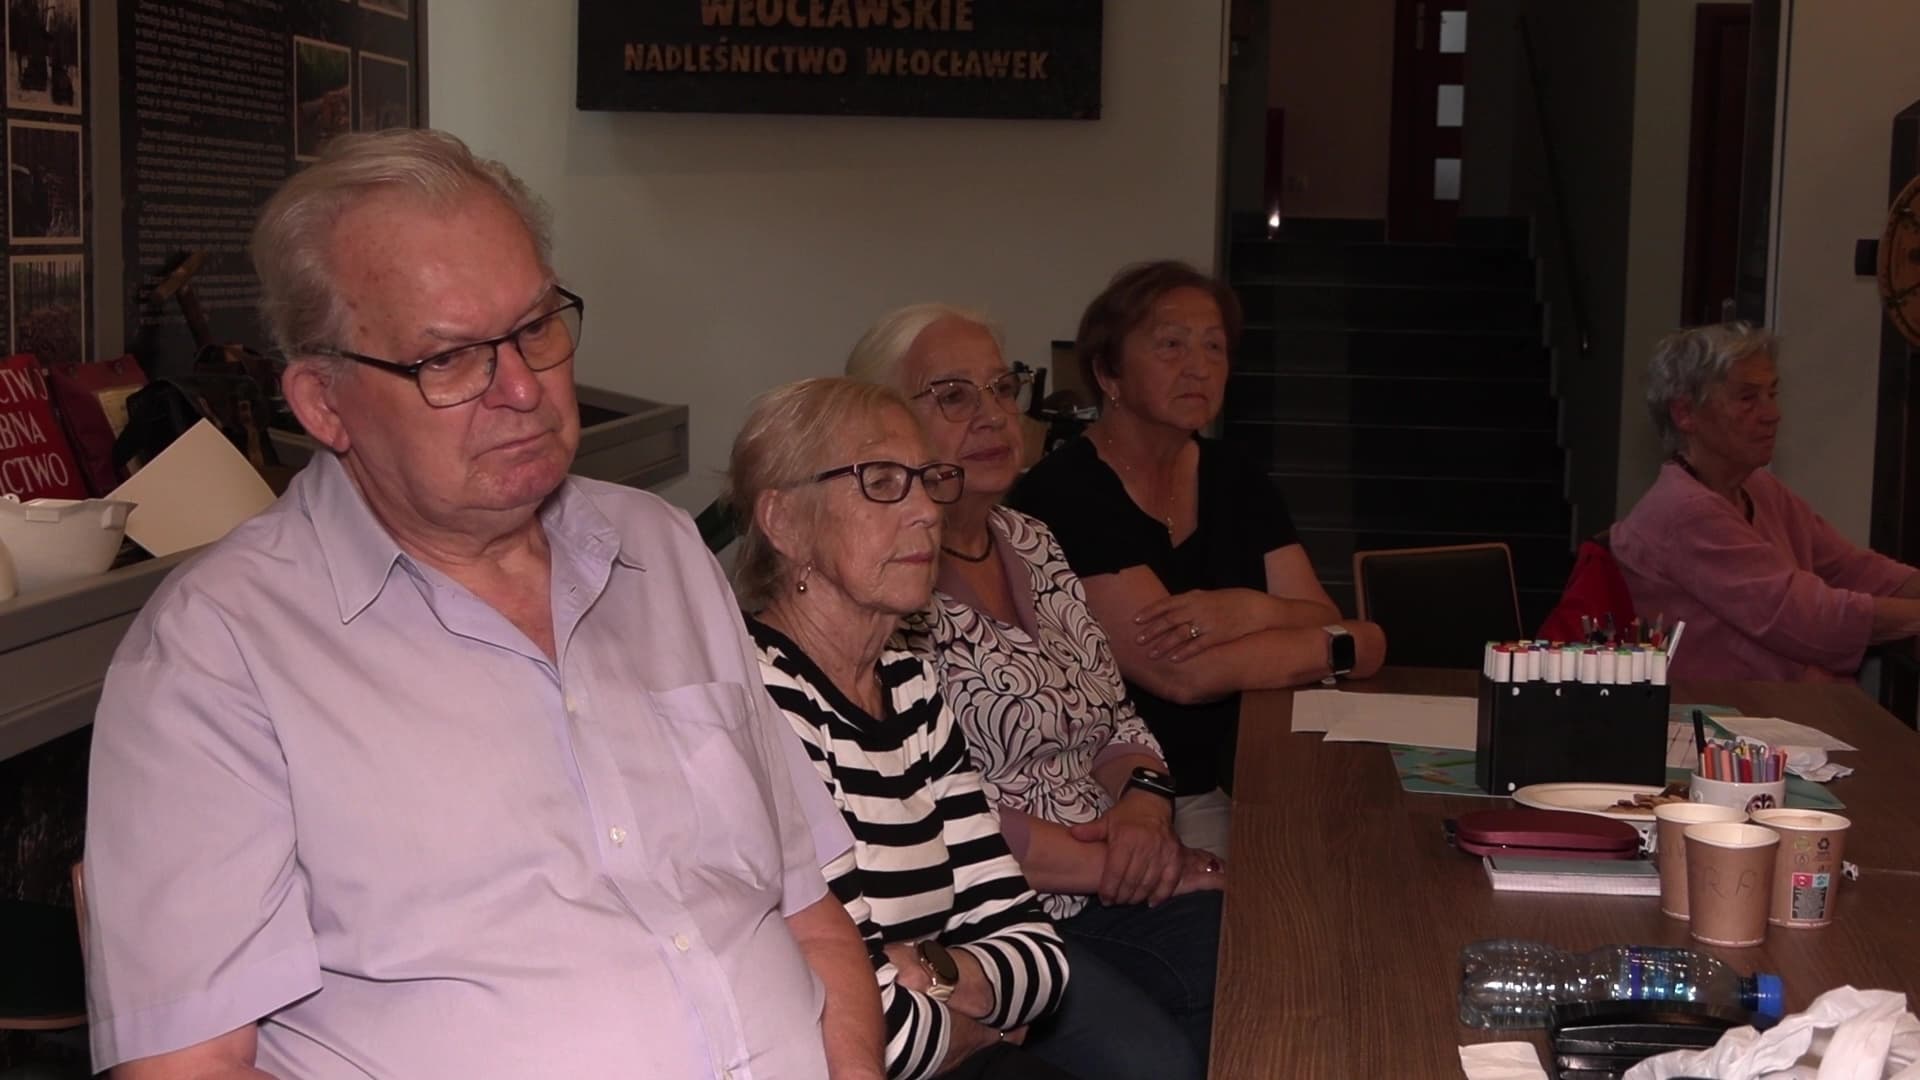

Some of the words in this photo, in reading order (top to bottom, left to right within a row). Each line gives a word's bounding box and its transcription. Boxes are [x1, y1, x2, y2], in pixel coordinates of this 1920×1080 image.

[701, 0, 976, 31] WŁOCŁAWSKIE
[623, 36, 848, 76] NADLEŚNICTWO
[865, 46, 1050, 81] WŁOCŁAWEK
